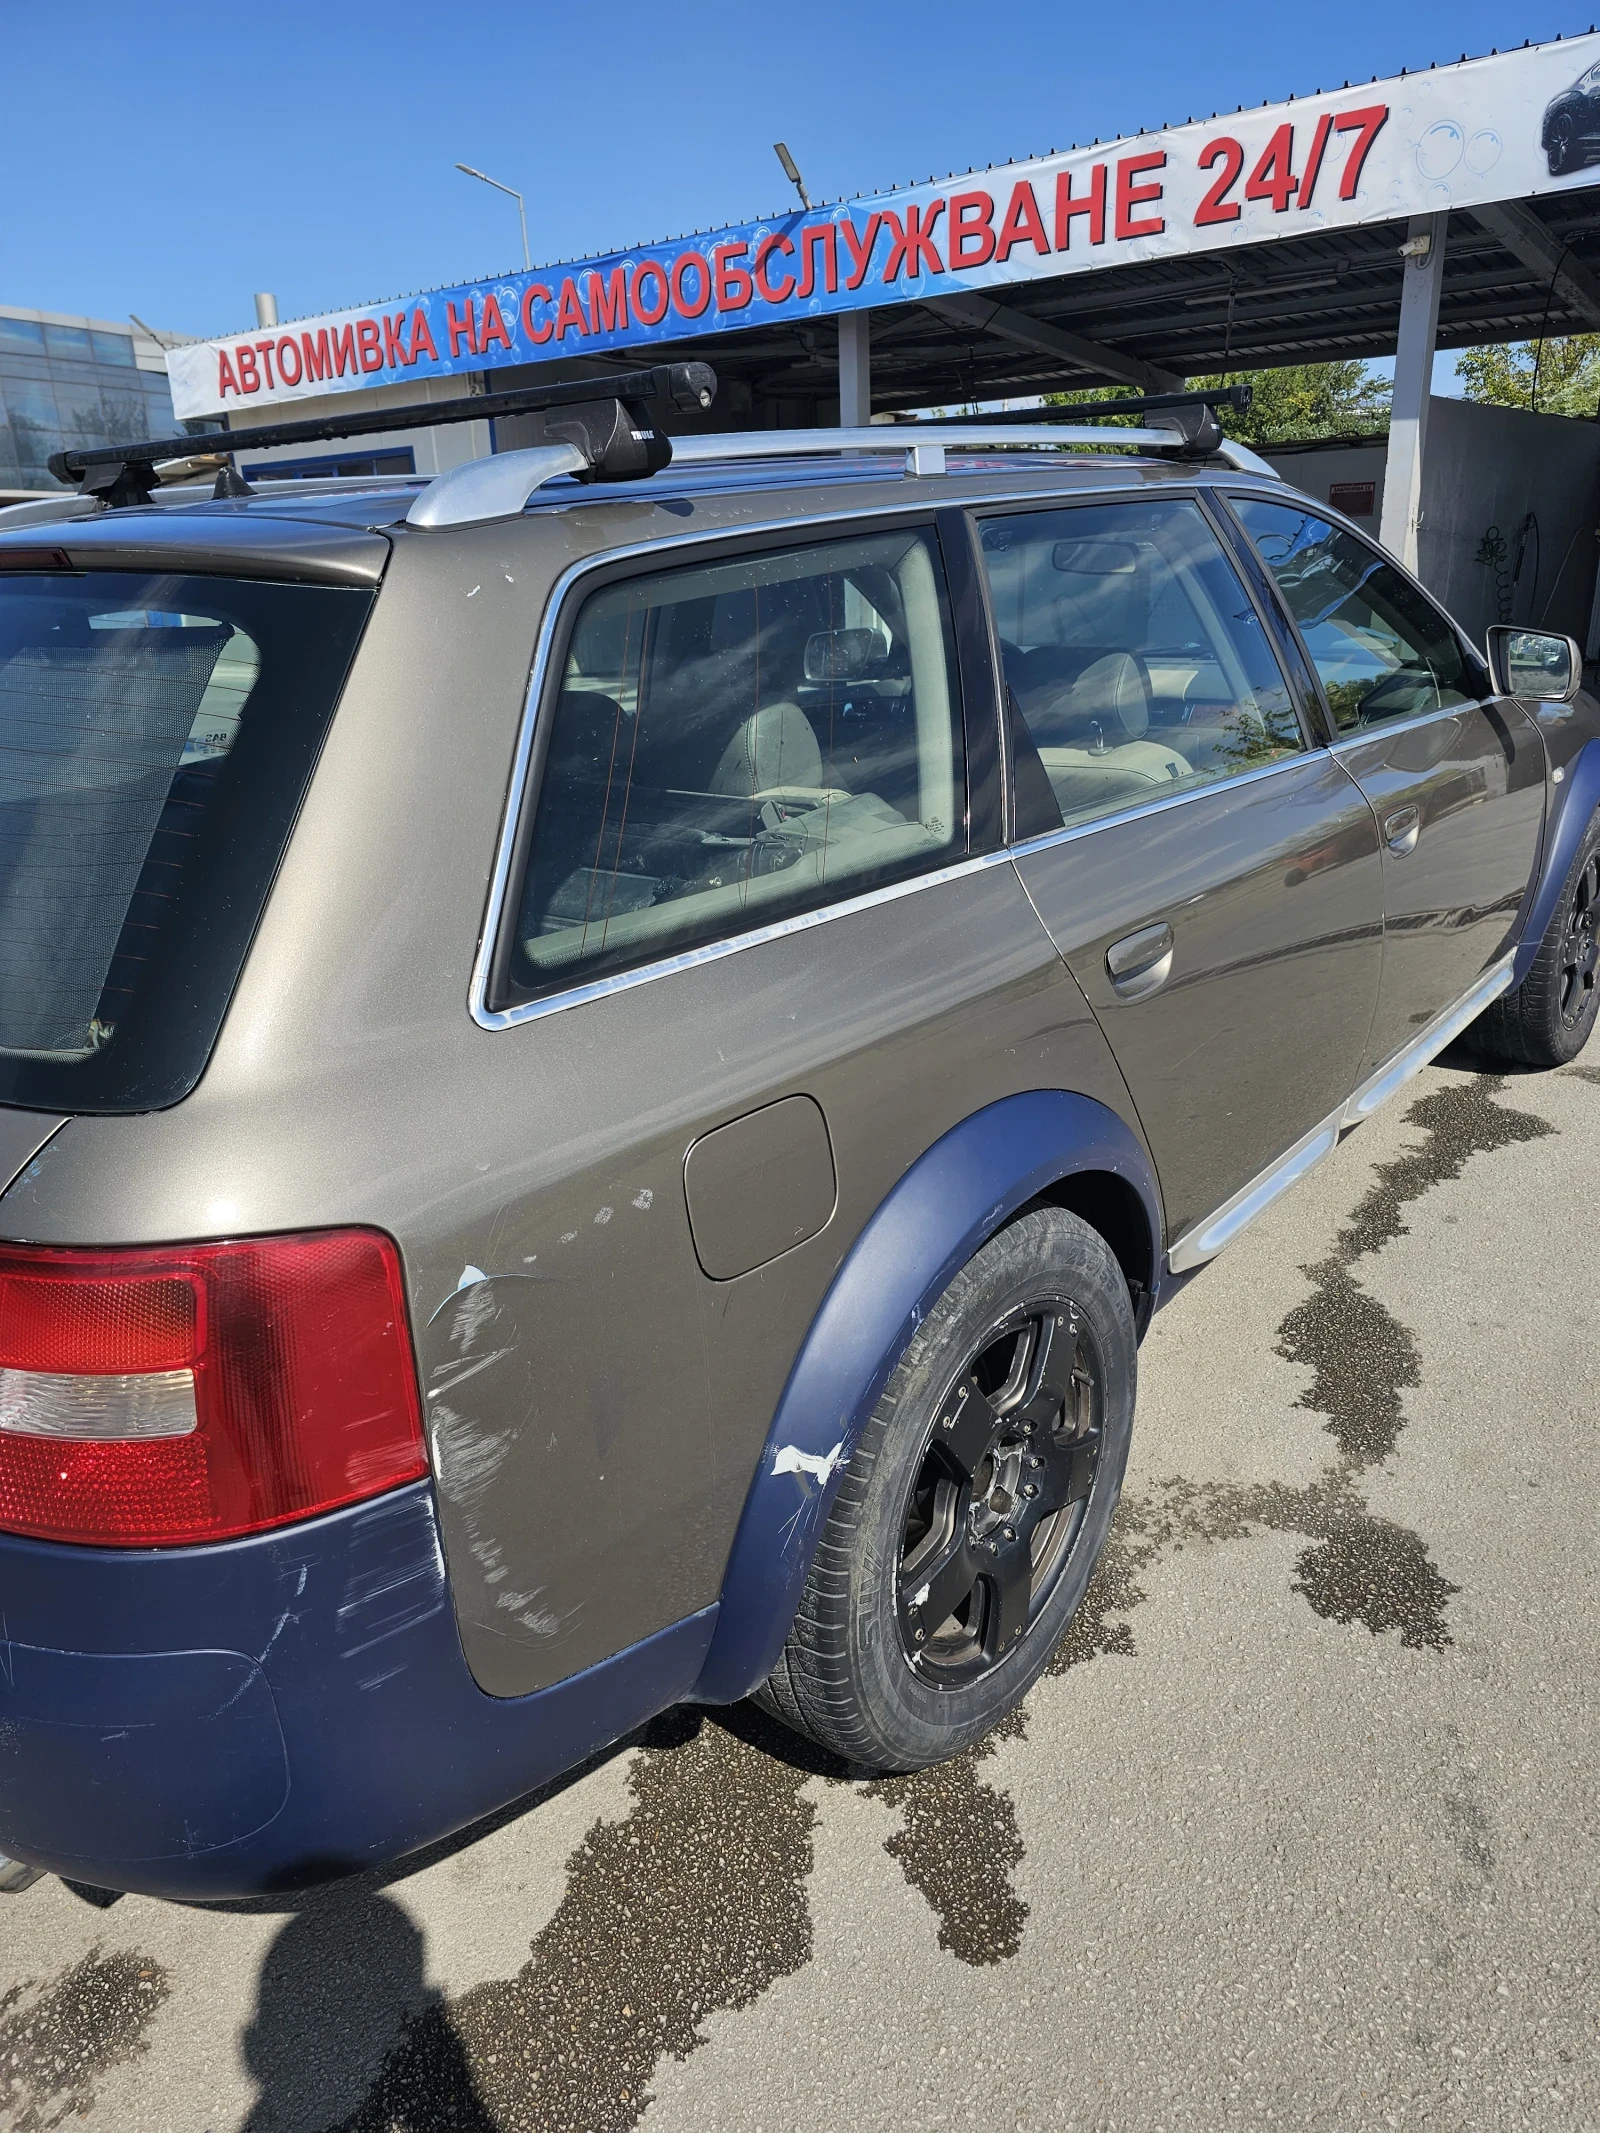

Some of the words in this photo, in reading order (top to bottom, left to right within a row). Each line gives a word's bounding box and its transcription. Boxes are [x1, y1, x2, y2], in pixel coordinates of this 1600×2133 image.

[218, 307, 439, 398] АВТОМИВКА
[446, 293, 512, 357] НА
[520, 149, 1167, 344] САМООБСЛУЖВАНЕ
[1193, 103, 1390, 227] 24/7
[631, 430, 655, 441] THULE
